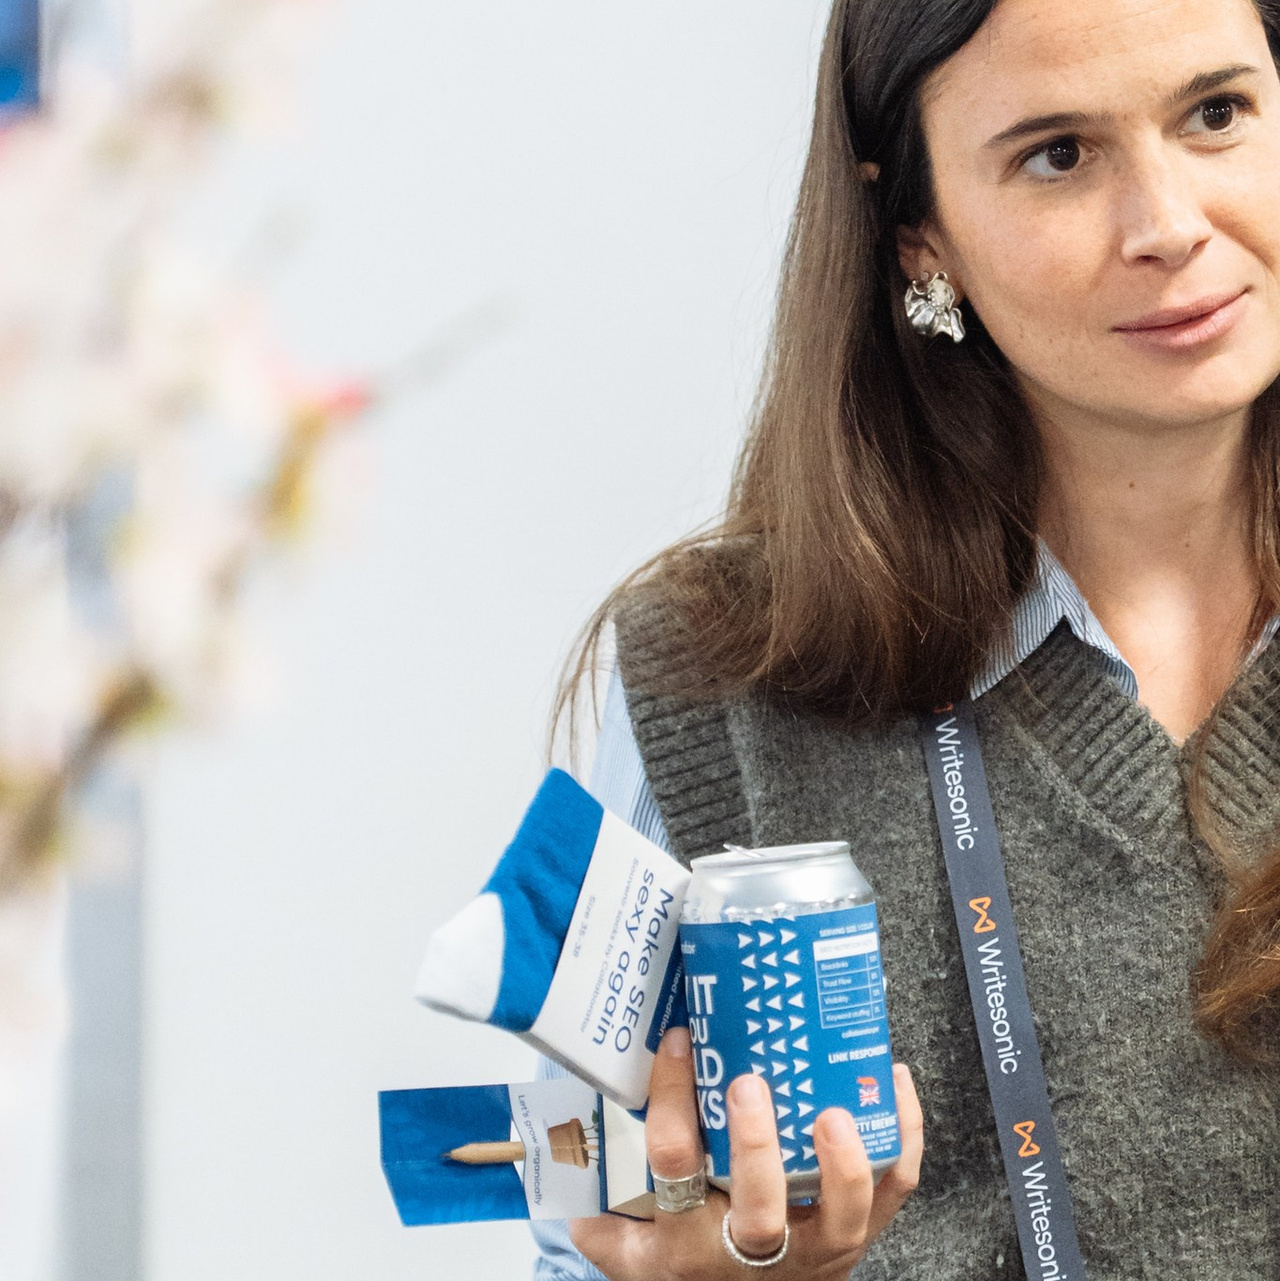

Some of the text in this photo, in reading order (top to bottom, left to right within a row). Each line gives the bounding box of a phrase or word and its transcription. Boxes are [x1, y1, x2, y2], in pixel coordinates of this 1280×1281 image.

[934, 718, 975, 851] Writesonic
[580, 858, 639, 1034] Souvenir socks by Collaborator
[582, 894, 597, 921] Size
[592, 869, 655, 1046] sexy again
[614, 888, 675, 1054] Make SEO
[658, 994, 675, 1038] edition
[828, 1052, 849, 1065] LINK
[976, 937, 1020, 1075] Writesonic
[518, 1094, 543, 1206] Let's grow organically
